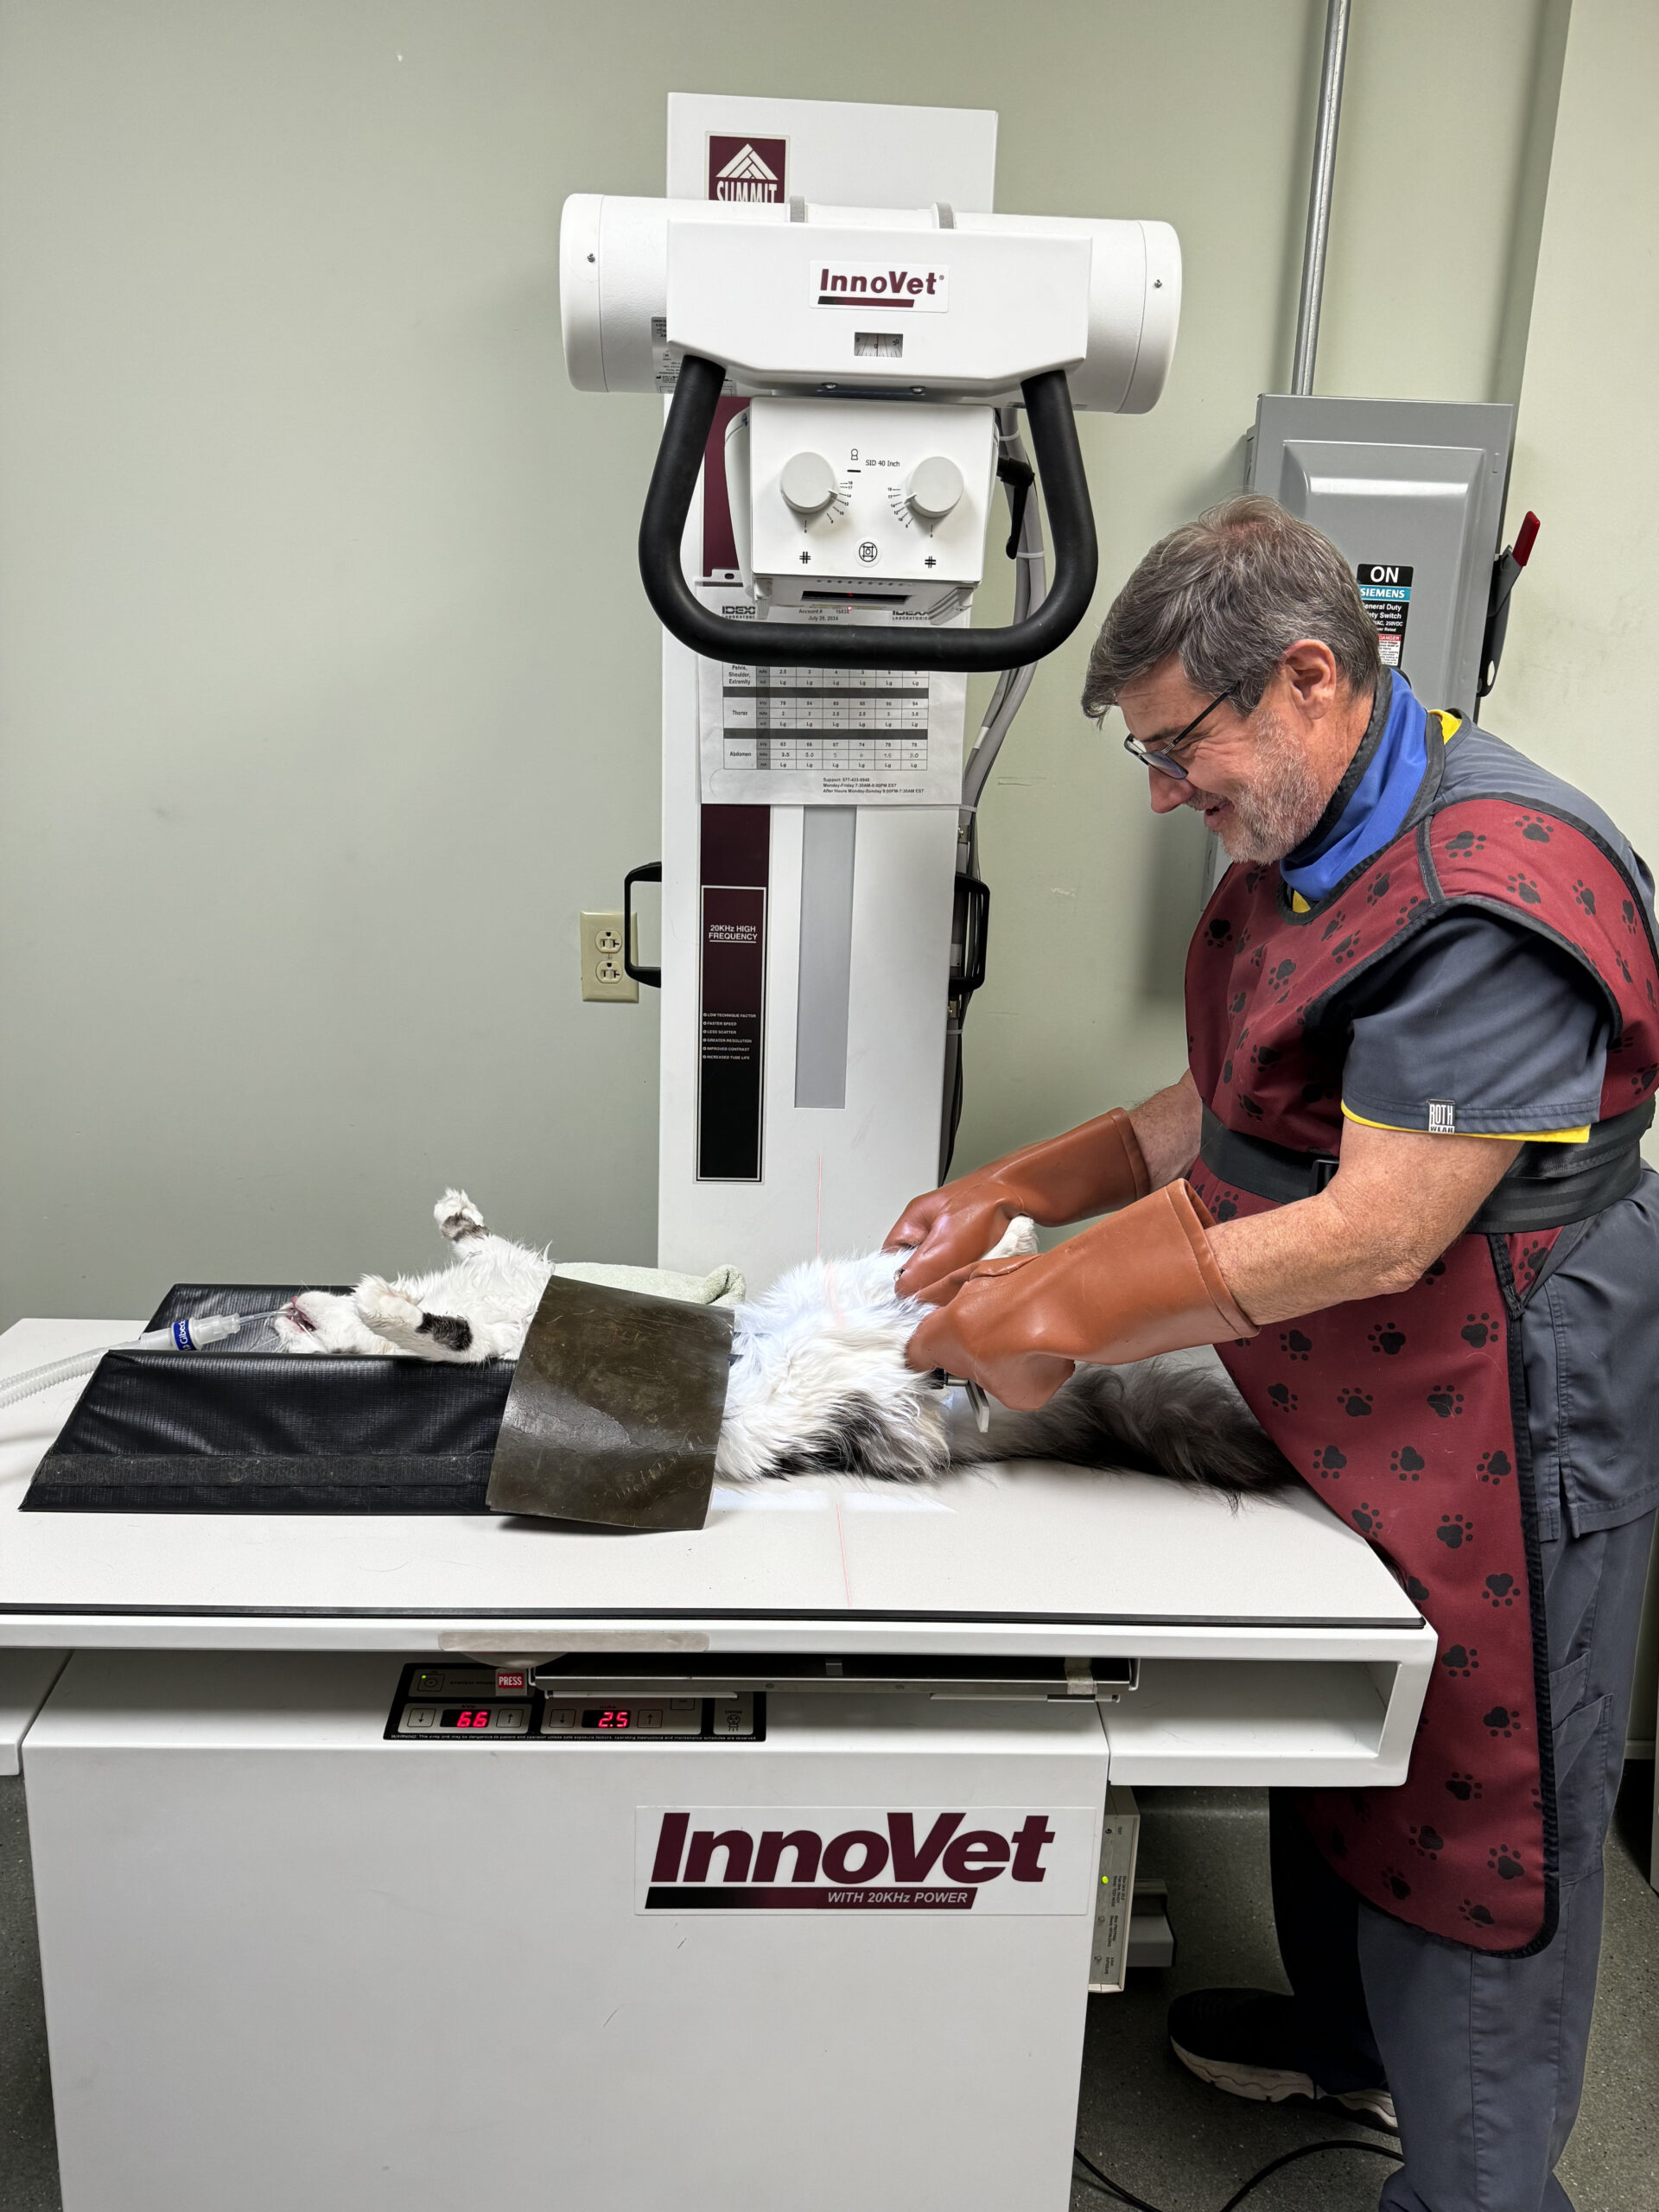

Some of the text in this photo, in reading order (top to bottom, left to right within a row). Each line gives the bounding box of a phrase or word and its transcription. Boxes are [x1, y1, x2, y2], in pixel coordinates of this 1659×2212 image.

[716, 180, 778, 203] SUMMIT
[1370, 566, 1399, 583] ON
[1360, 588, 1405, 598] SIEMENS
[1429, 1103, 1453, 1125] ROTH
[499, 1676, 522, 1686] PRESS
[456, 1711, 487, 1728] 66
[598, 1712, 628, 1727] 2.5
[651, 1812, 1056, 1884] InnoVet
[828, 1891, 968, 1903] WITH 20KHz POWER
